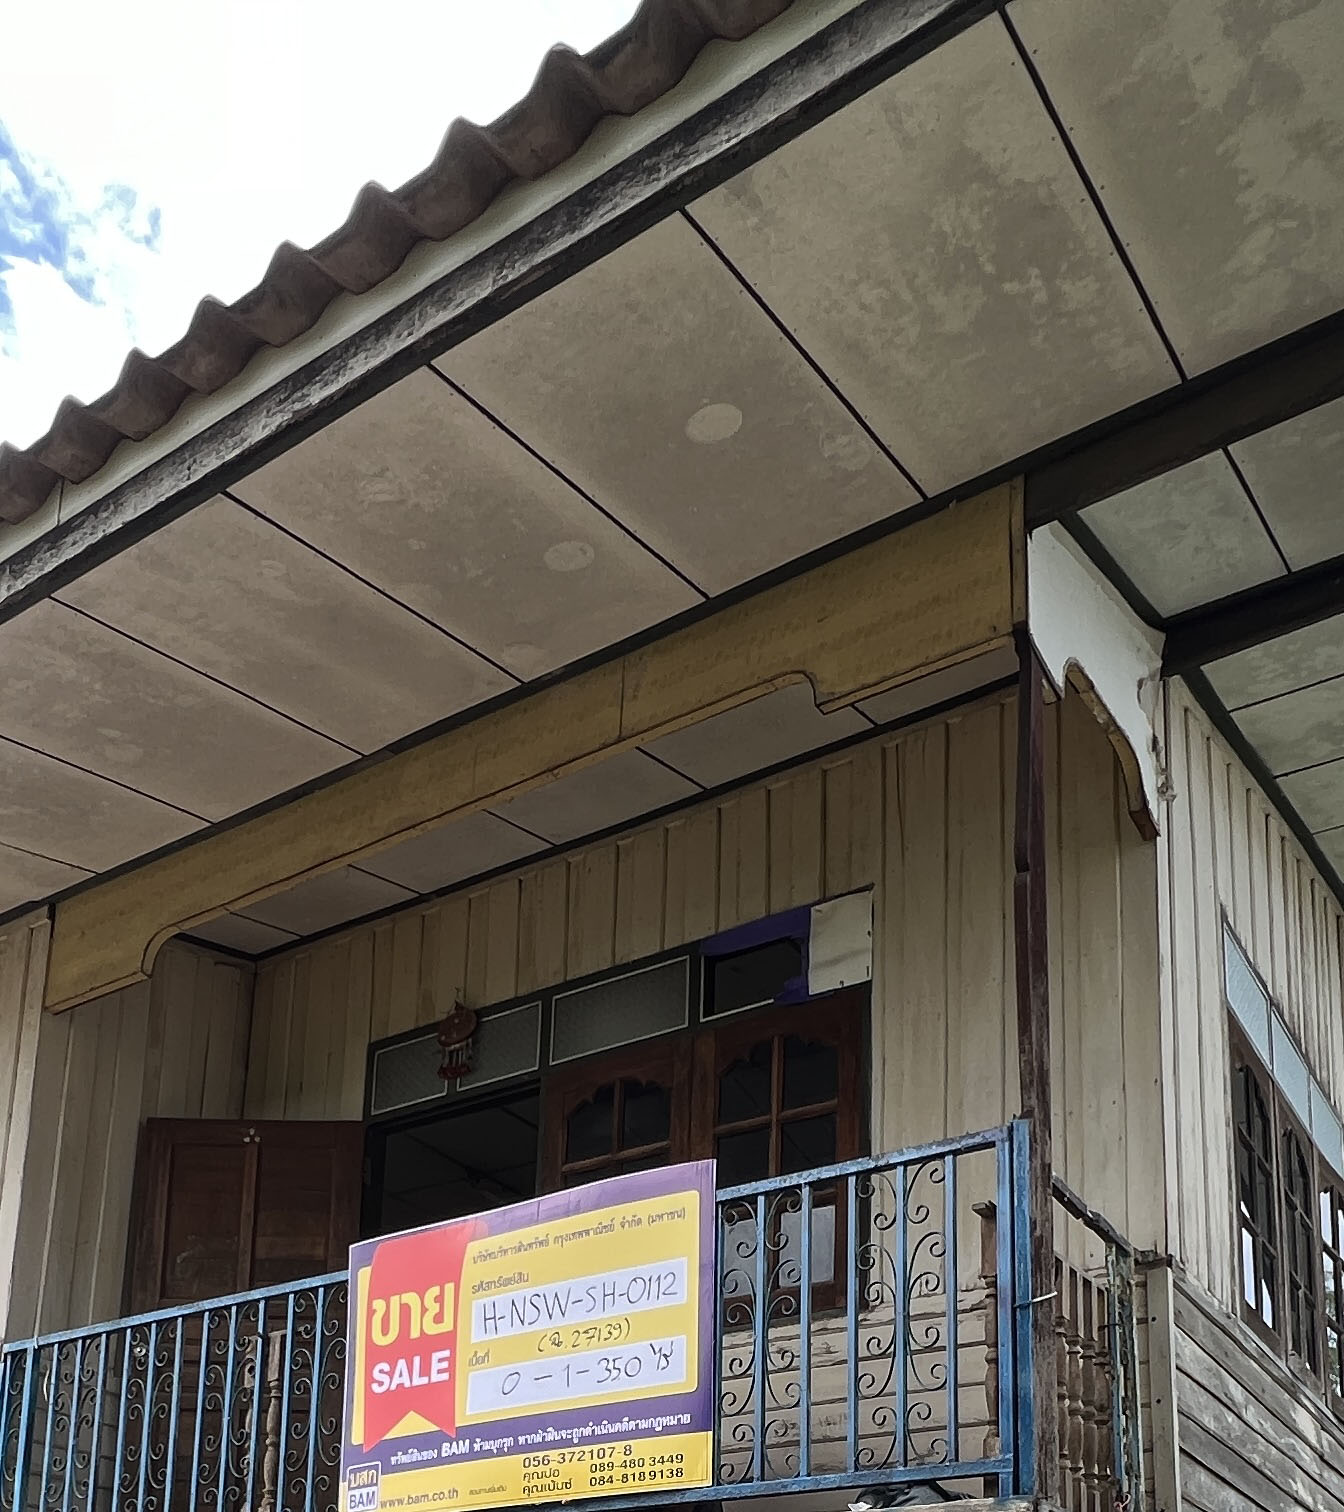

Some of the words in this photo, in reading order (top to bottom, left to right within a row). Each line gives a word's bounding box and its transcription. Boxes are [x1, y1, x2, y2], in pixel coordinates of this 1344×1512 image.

[620, 1214, 642, 1230] จำกัด
[647, 1207, 686, 1226] (มหาชน)
[372, 1281, 455, 1346] ขาย
[371, 1349, 451, 1394] SALE
[441, 1438, 470, 1458] BAM
[473, 1436, 514, 1455] ห้ามบุกรุก
[523, 1444, 633, 1469] 056-372107-8
[350, 1469, 377, 1488] บสก
[349, 1491, 376, 1509] BAM
[380, 1488, 459, 1509] www.bam.co.th
